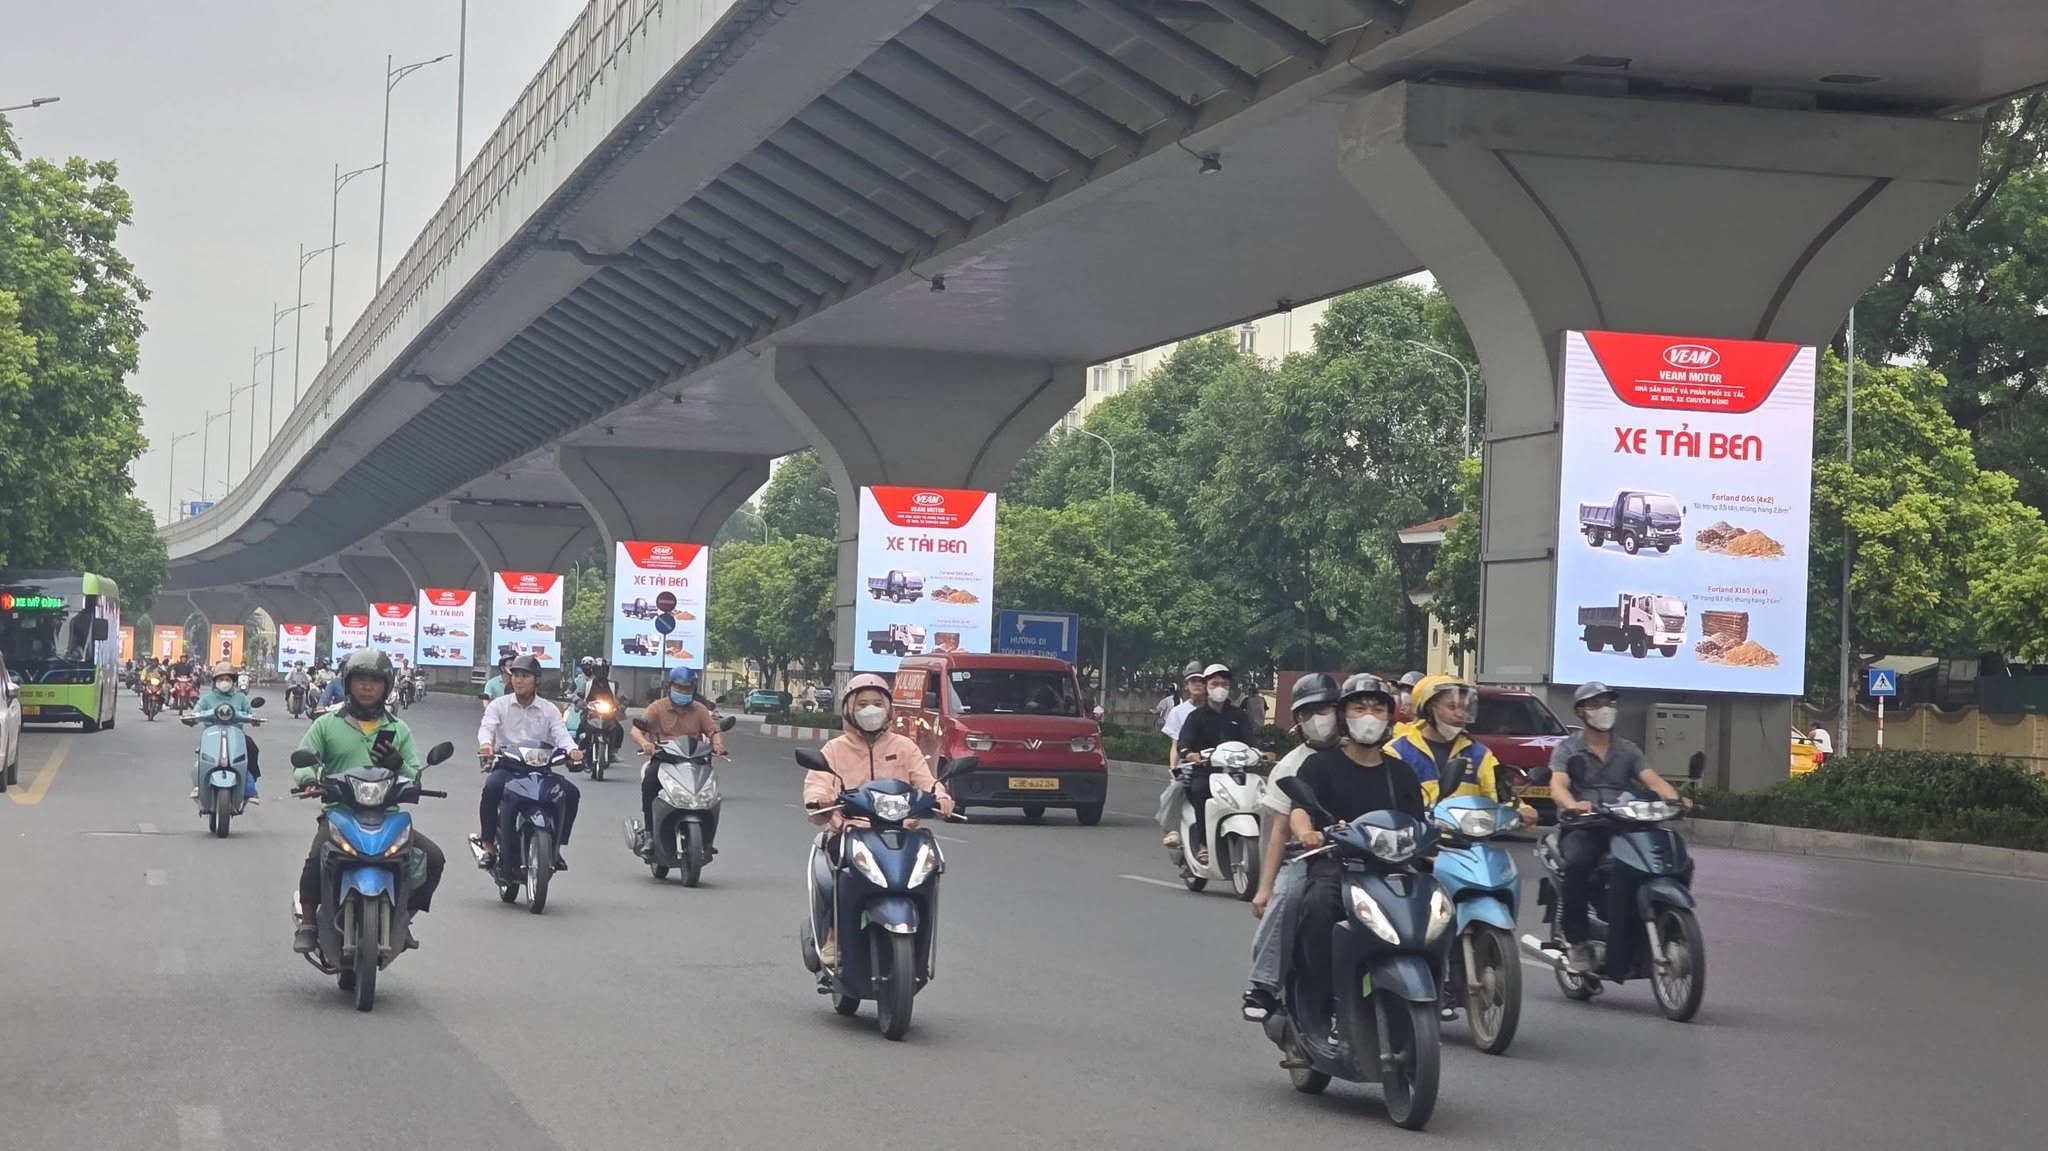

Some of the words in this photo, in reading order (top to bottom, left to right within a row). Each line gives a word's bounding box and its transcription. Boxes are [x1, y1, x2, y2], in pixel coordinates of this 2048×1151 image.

[1669, 349, 1713, 365] VEAM
[1659, 370, 1687, 381] VEAM
[1689, 372, 1722, 383] MOTOR
[1649, 384, 1661, 393] SẢN
[1663, 385, 1679, 393] XUẤT
[1680, 386, 1688, 394] VÀ
[1686, 396, 1711, 404] CHUYÊN
[1712, 397, 1729, 405] DÙNG
[1614, 427, 1647, 455] XE
[1655, 423, 1701, 458] TẢI
[1709, 433, 1762, 461] BEN
[916, 495, 940, 504] VEAM
[1712, 493, 1740, 502] Forland
[1741, 495, 1755, 503] D65
[1756, 496, 1774, 504] (4x2)
[886, 536, 905, 551] XE
[909, 534, 934, 553] TẢI
[938, 540, 968, 554] BEN
[634, 575, 646, 585] XE
[649, 573, 666, 586] TẢI
[1708, 585, 1734, 593] Forland
[1752, 588, 1768, 596] (4x4)
[507, 597, 517, 605] XE
